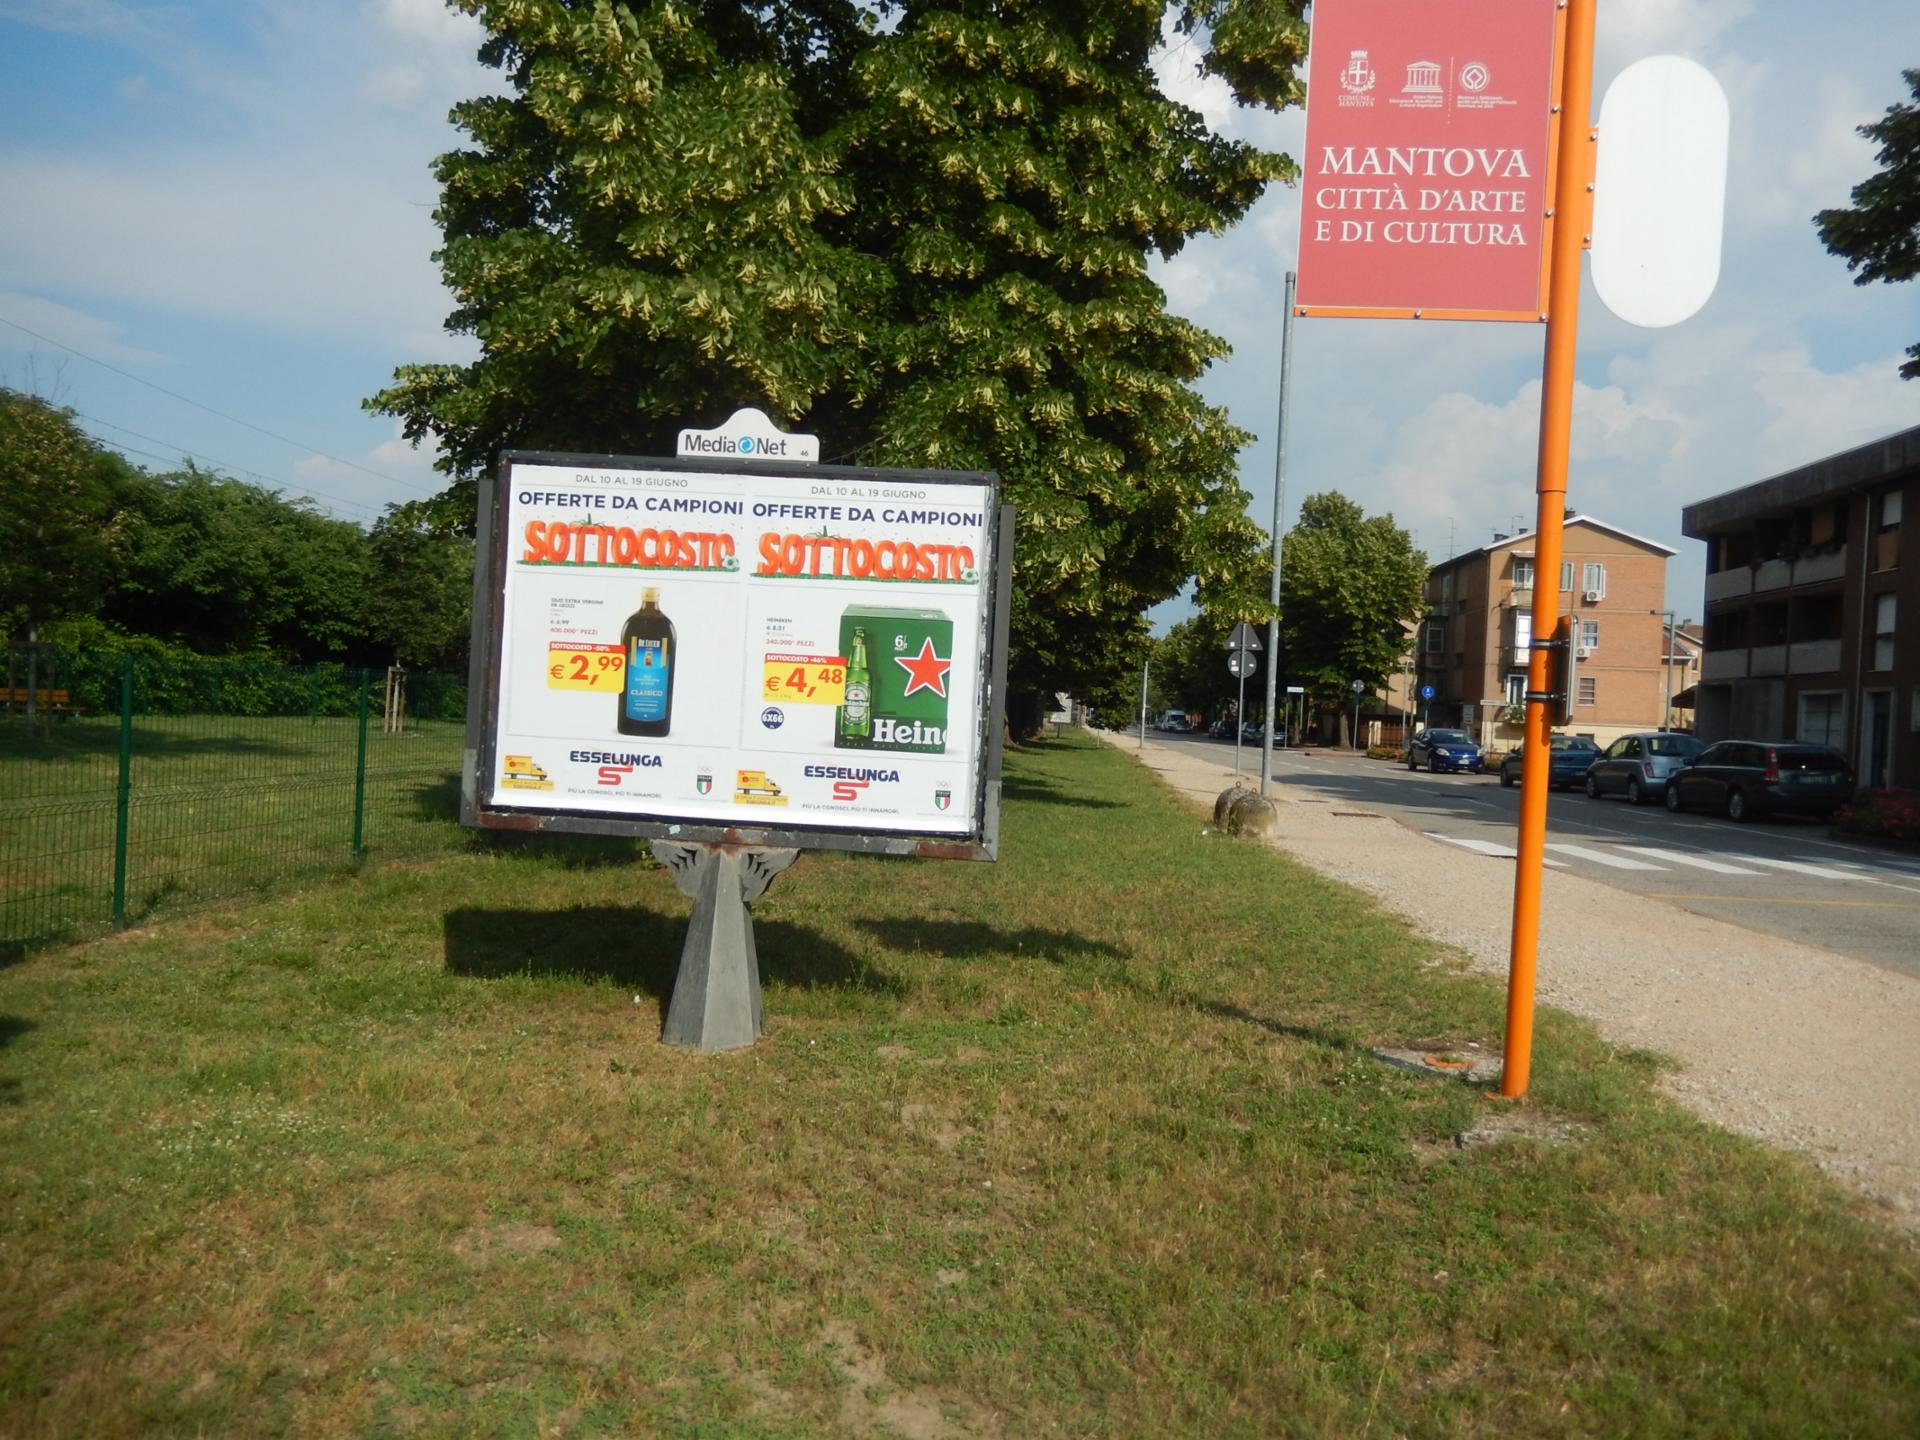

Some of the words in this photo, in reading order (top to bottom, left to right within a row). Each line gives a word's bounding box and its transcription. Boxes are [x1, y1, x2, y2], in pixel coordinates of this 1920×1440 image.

[1319, 147, 1531, 178] MANTOVA
[1316, 183, 1408, 211] CITTÀ
[1419, 189, 1526, 213] D'ARTE
[1314, 220, 1331, 242] E
[1341, 221, 1375, 243] DI
[1383, 221, 1527, 246] CULTURA
[685, 435, 736, 454] Media
[756, 438, 787, 456] Net
[575, 474, 596, 484] DAL
[600, 475, 611, 485] 10
[615, 476, 629, 486] AL
[632, 477, 642, 486] 19
[646, 478, 688, 488] GIUGNO
[811, 486, 832, 496] DAL
[836, 487, 848, 497] 10
[851, 488, 864, 497] AL
[868, 488, 879, 498] 19
[882, 489, 926, 500] GIUGNO
[518, 491, 606, 509] OFFERTE
[612, 496, 638, 511] DA
[645, 498, 743, 515] CAMPIONI
[752, 503, 842, 521] OFFERTE
[848, 507, 876, 522] DA
[882, 510, 983, 527] CAMPIONI
[523, 519, 736, 569] SOTTOCOSTO
[756, 531, 974, 581] SOTTOCOSTO
[551, 642, 592, 651] SOTTOCOSTO
[550, 664, 566, 680] €
[569, 654, 623, 685] 2,99
[767, 655, 809, 663] SOTTOCOSTO
[765, 676, 781, 692] €
[785, 667, 844, 698] 4,48
[570, 750, 662, 768] ESSELUNGA
[804, 765, 900, 783] ESSELUNGA
